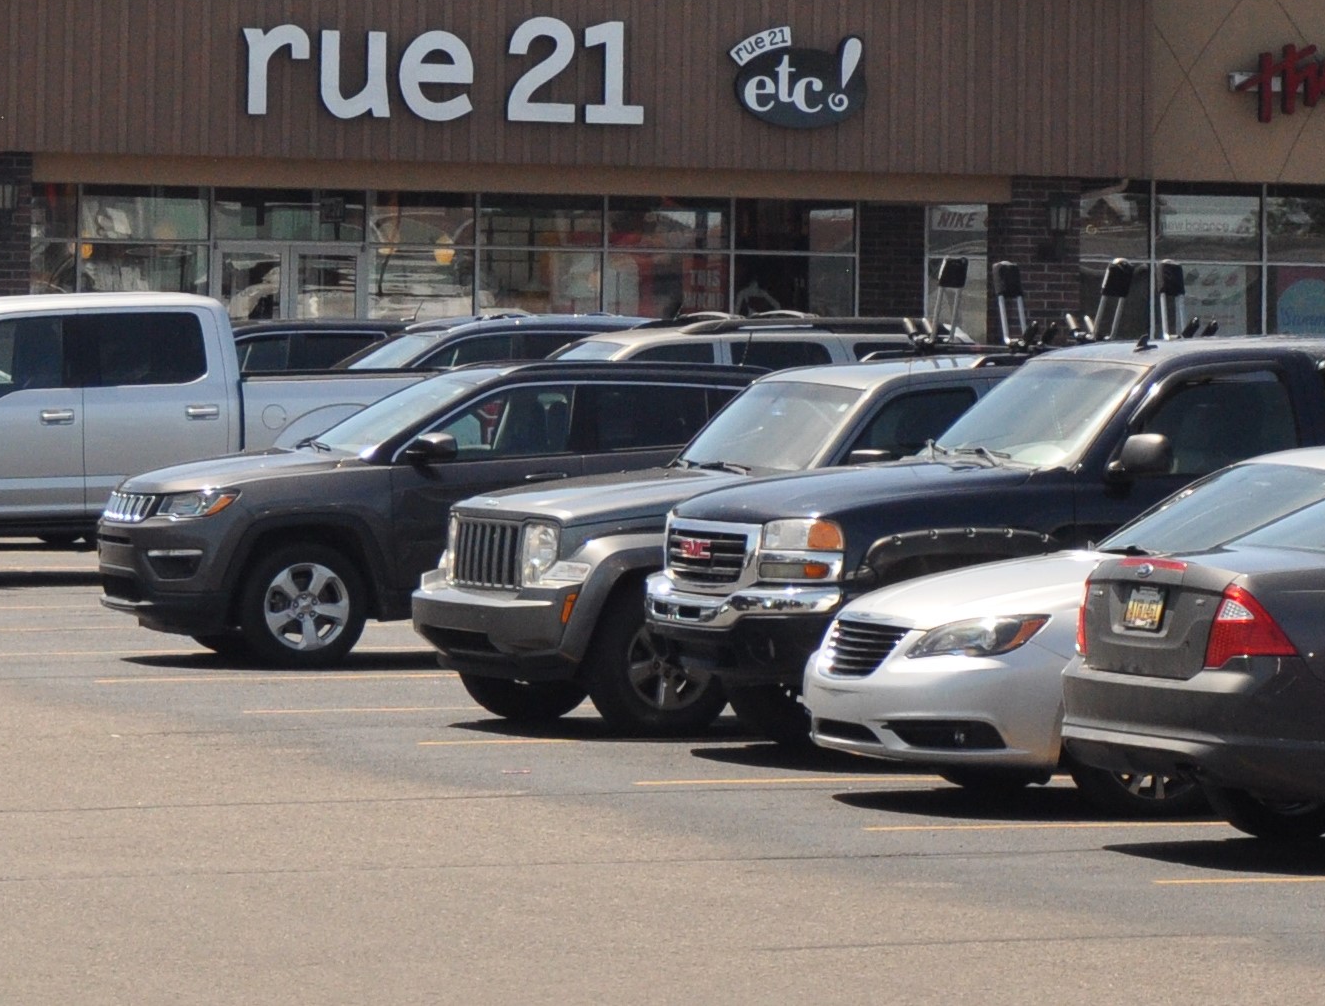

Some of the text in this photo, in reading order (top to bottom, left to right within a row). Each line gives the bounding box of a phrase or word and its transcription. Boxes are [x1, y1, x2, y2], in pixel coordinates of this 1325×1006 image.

[243, 16, 644, 124] rue 21
[734, 28, 789, 62] rue 21
[744, 37, 863, 113] etc!
[937, 211, 978, 228] NIKE
